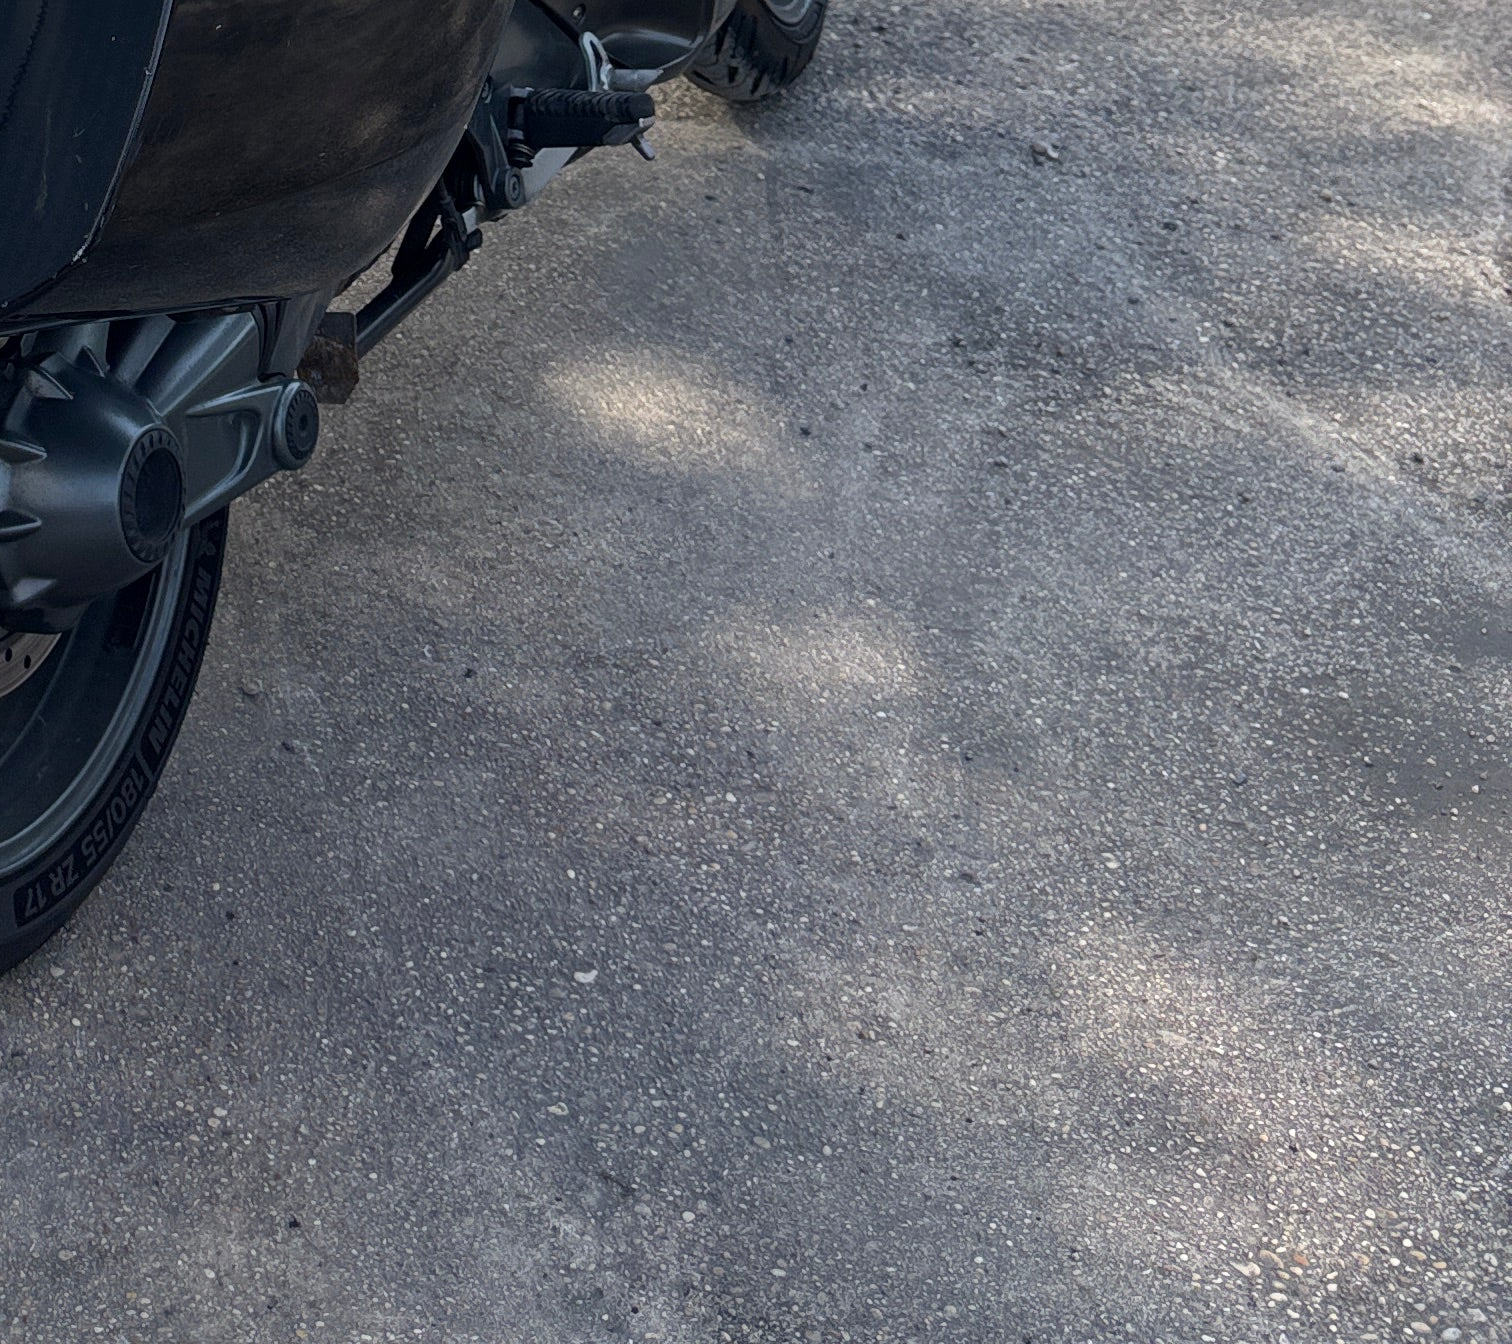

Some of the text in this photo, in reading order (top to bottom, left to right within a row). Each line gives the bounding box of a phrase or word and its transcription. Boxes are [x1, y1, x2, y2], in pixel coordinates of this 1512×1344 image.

[147, 569, 214, 754] MICHELIN
[81, 768, 147, 866] 180/55
[24, 881, 47, 917] 17
